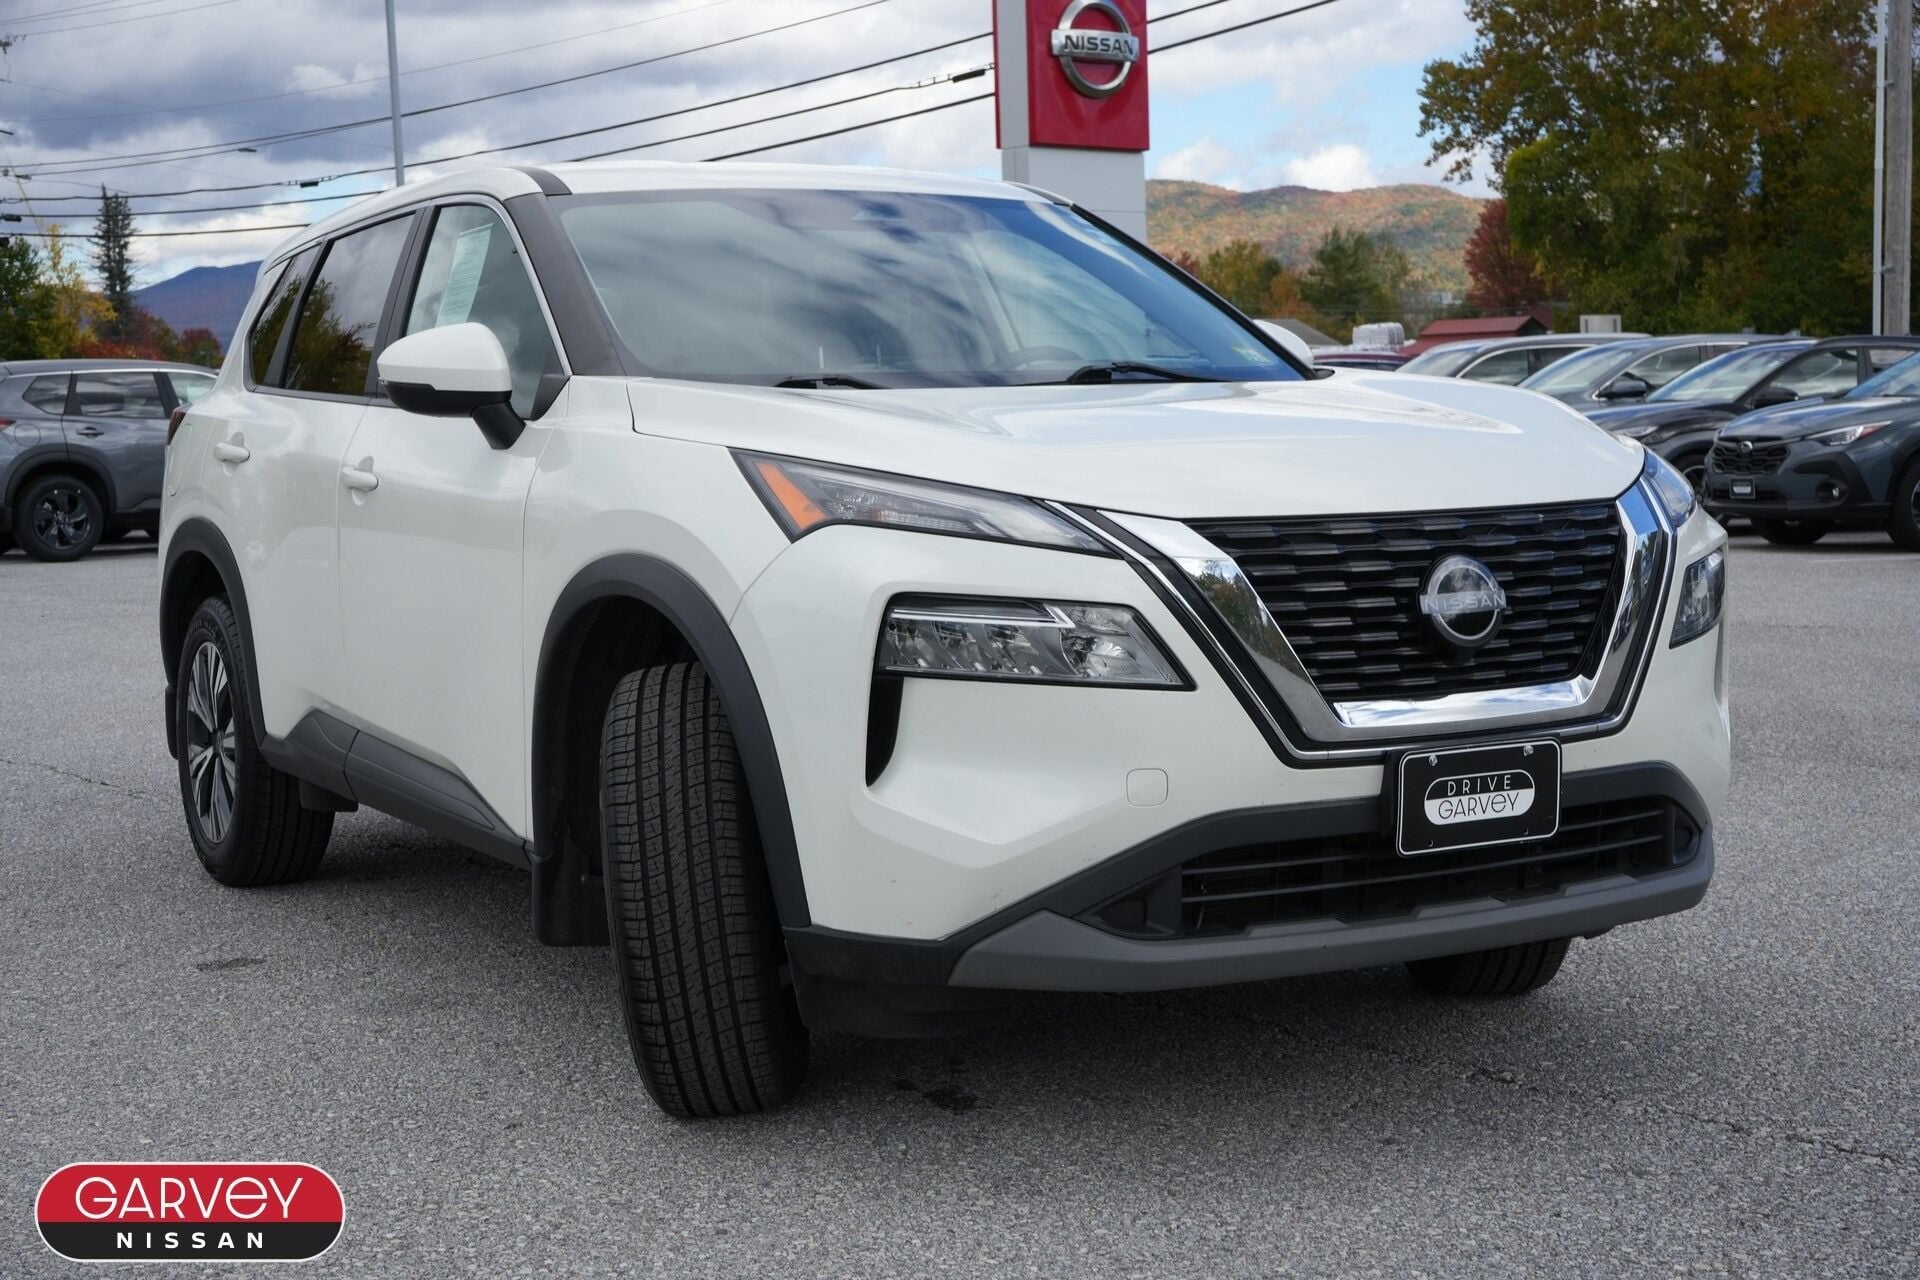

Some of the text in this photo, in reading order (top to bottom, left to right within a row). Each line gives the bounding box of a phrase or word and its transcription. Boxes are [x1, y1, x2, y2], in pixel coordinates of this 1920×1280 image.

[1064, 35, 1133, 55] NISSAN
[1424, 593, 1505, 614] NISSAN
[1447, 775, 1512, 796] DRIVE
